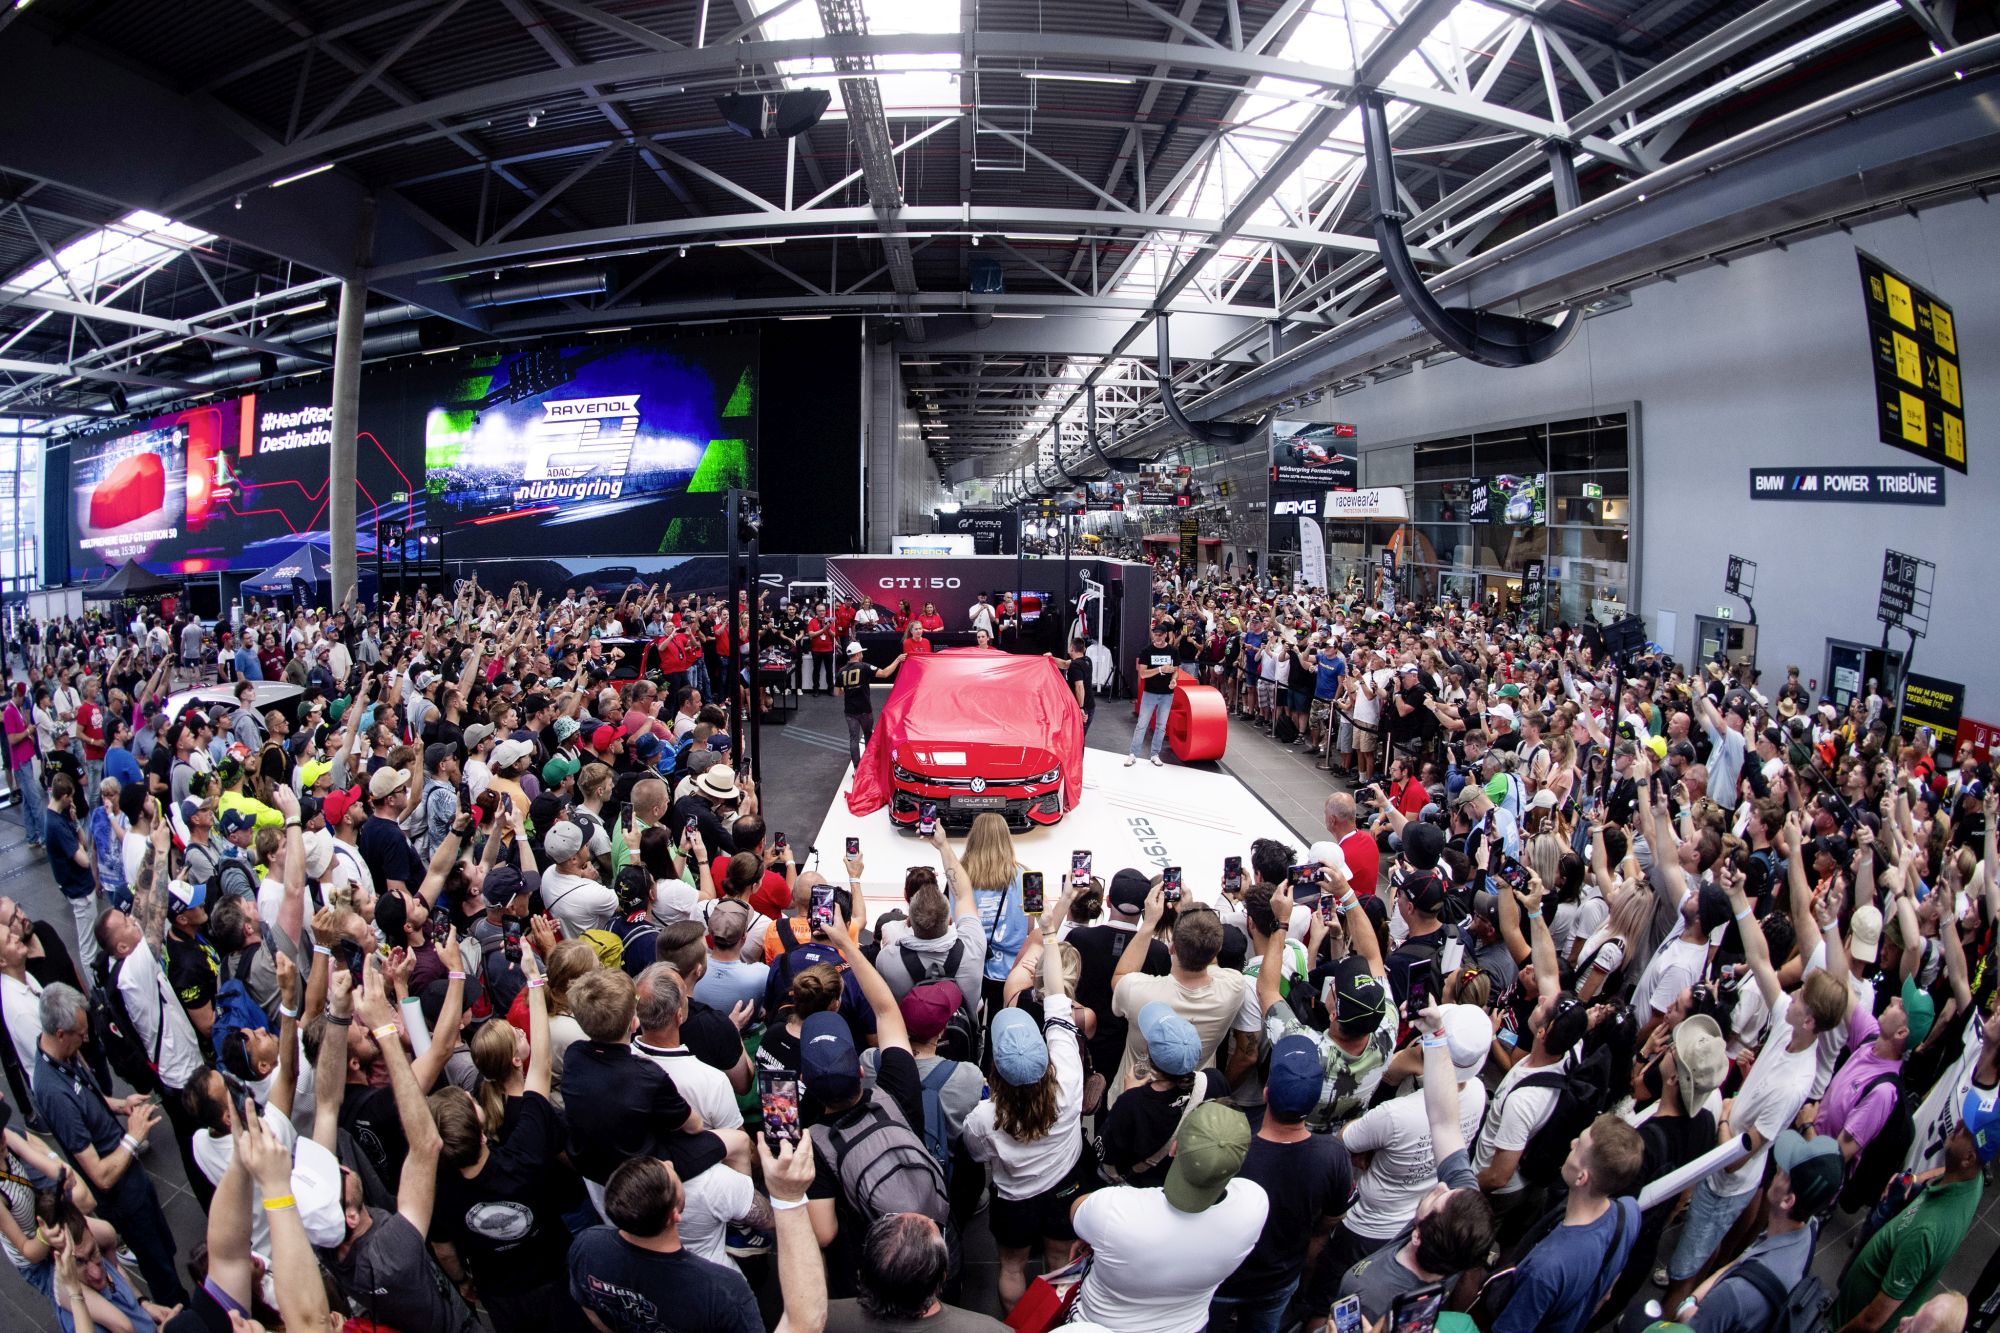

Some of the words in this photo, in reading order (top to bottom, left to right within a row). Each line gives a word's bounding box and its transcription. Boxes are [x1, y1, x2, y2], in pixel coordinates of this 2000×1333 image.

[551, 401, 631, 416] RAVENOL
[546, 467, 571, 478] ADAC
[520, 478, 623, 500] nürburgring
[1755, 475, 1785, 491] BMW
[1823, 475, 1870, 492] POWER
[1876, 472, 1938, 494] TRIBÜNE
[1335, 491, 1379, 507] racewear24
[1472, 485, 1487, 502] FAN
[1285, 499, 1317, 514] AMG
[1470, 498, 1488, 516] SHOP
[143, 529, 168, 542] EDITION
[168, 528, 178, 539] 50
[137, 544, 147, 555] Uhr
[878, 577, 922, 589] GTI
[930, 577, 961, 589] 50
[1882, 580, 1901, 593] BLOCK
[1881, 593, 1904, 608] ZUGANG
[1903, 602, 1908, 610] 3
[1879, 606, 1898, 619] ENTRY
[842, 668, 861, 686] 10
[1906, 693, 1933, 707] TRIBÜNE
[1907, 684, 1924, 695] BMW
[1923, 689, 1930, 697] M
[1930, 690, 1954, 703] POWER
